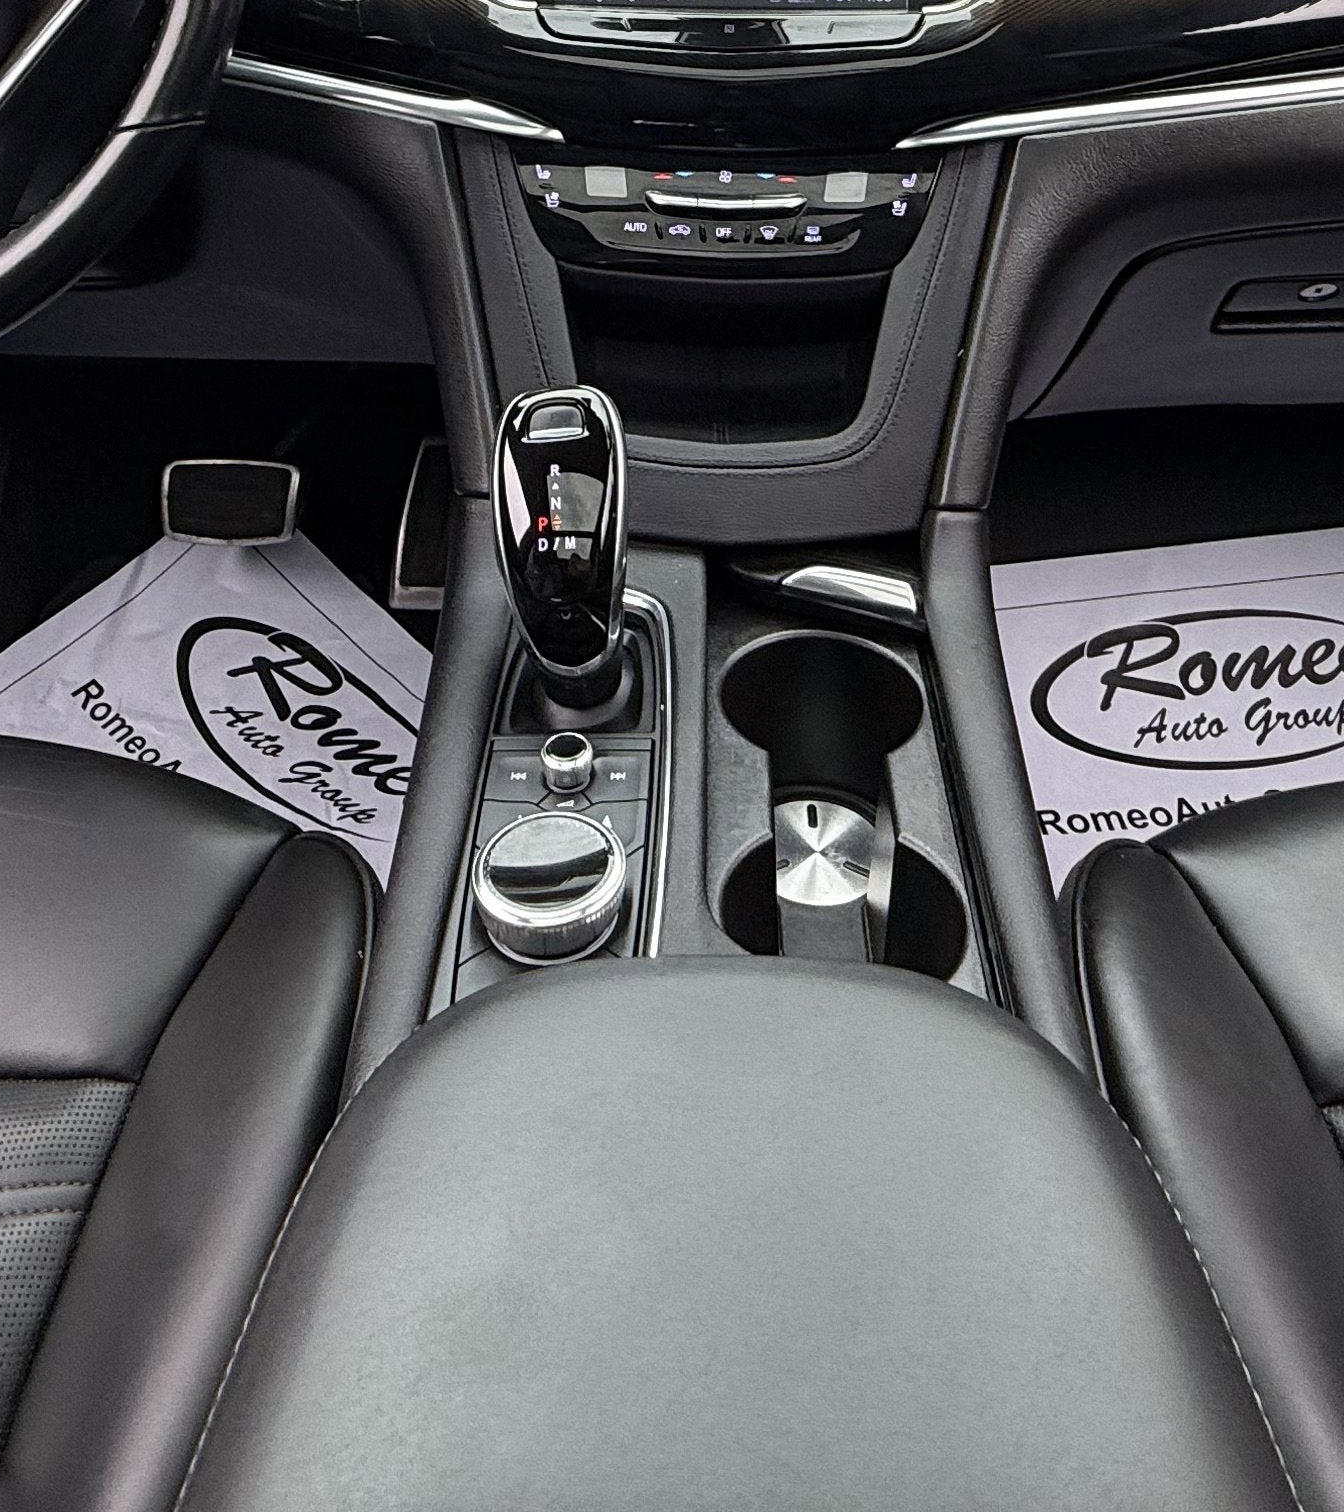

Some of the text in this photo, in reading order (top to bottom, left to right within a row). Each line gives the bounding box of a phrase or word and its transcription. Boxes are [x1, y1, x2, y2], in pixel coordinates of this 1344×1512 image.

[624, 221, 647, 232] AUTO
[716, 227, 732, 238] OFF
[550, 464, 561, 477] R
[550, 496, 561, 510] N
[538, 516, 549, 532] P
[227, 631, 412, 796] Rome
[1134, 706, 1228, 748] Auto
[210, 703, 378, 825] Auto Group
